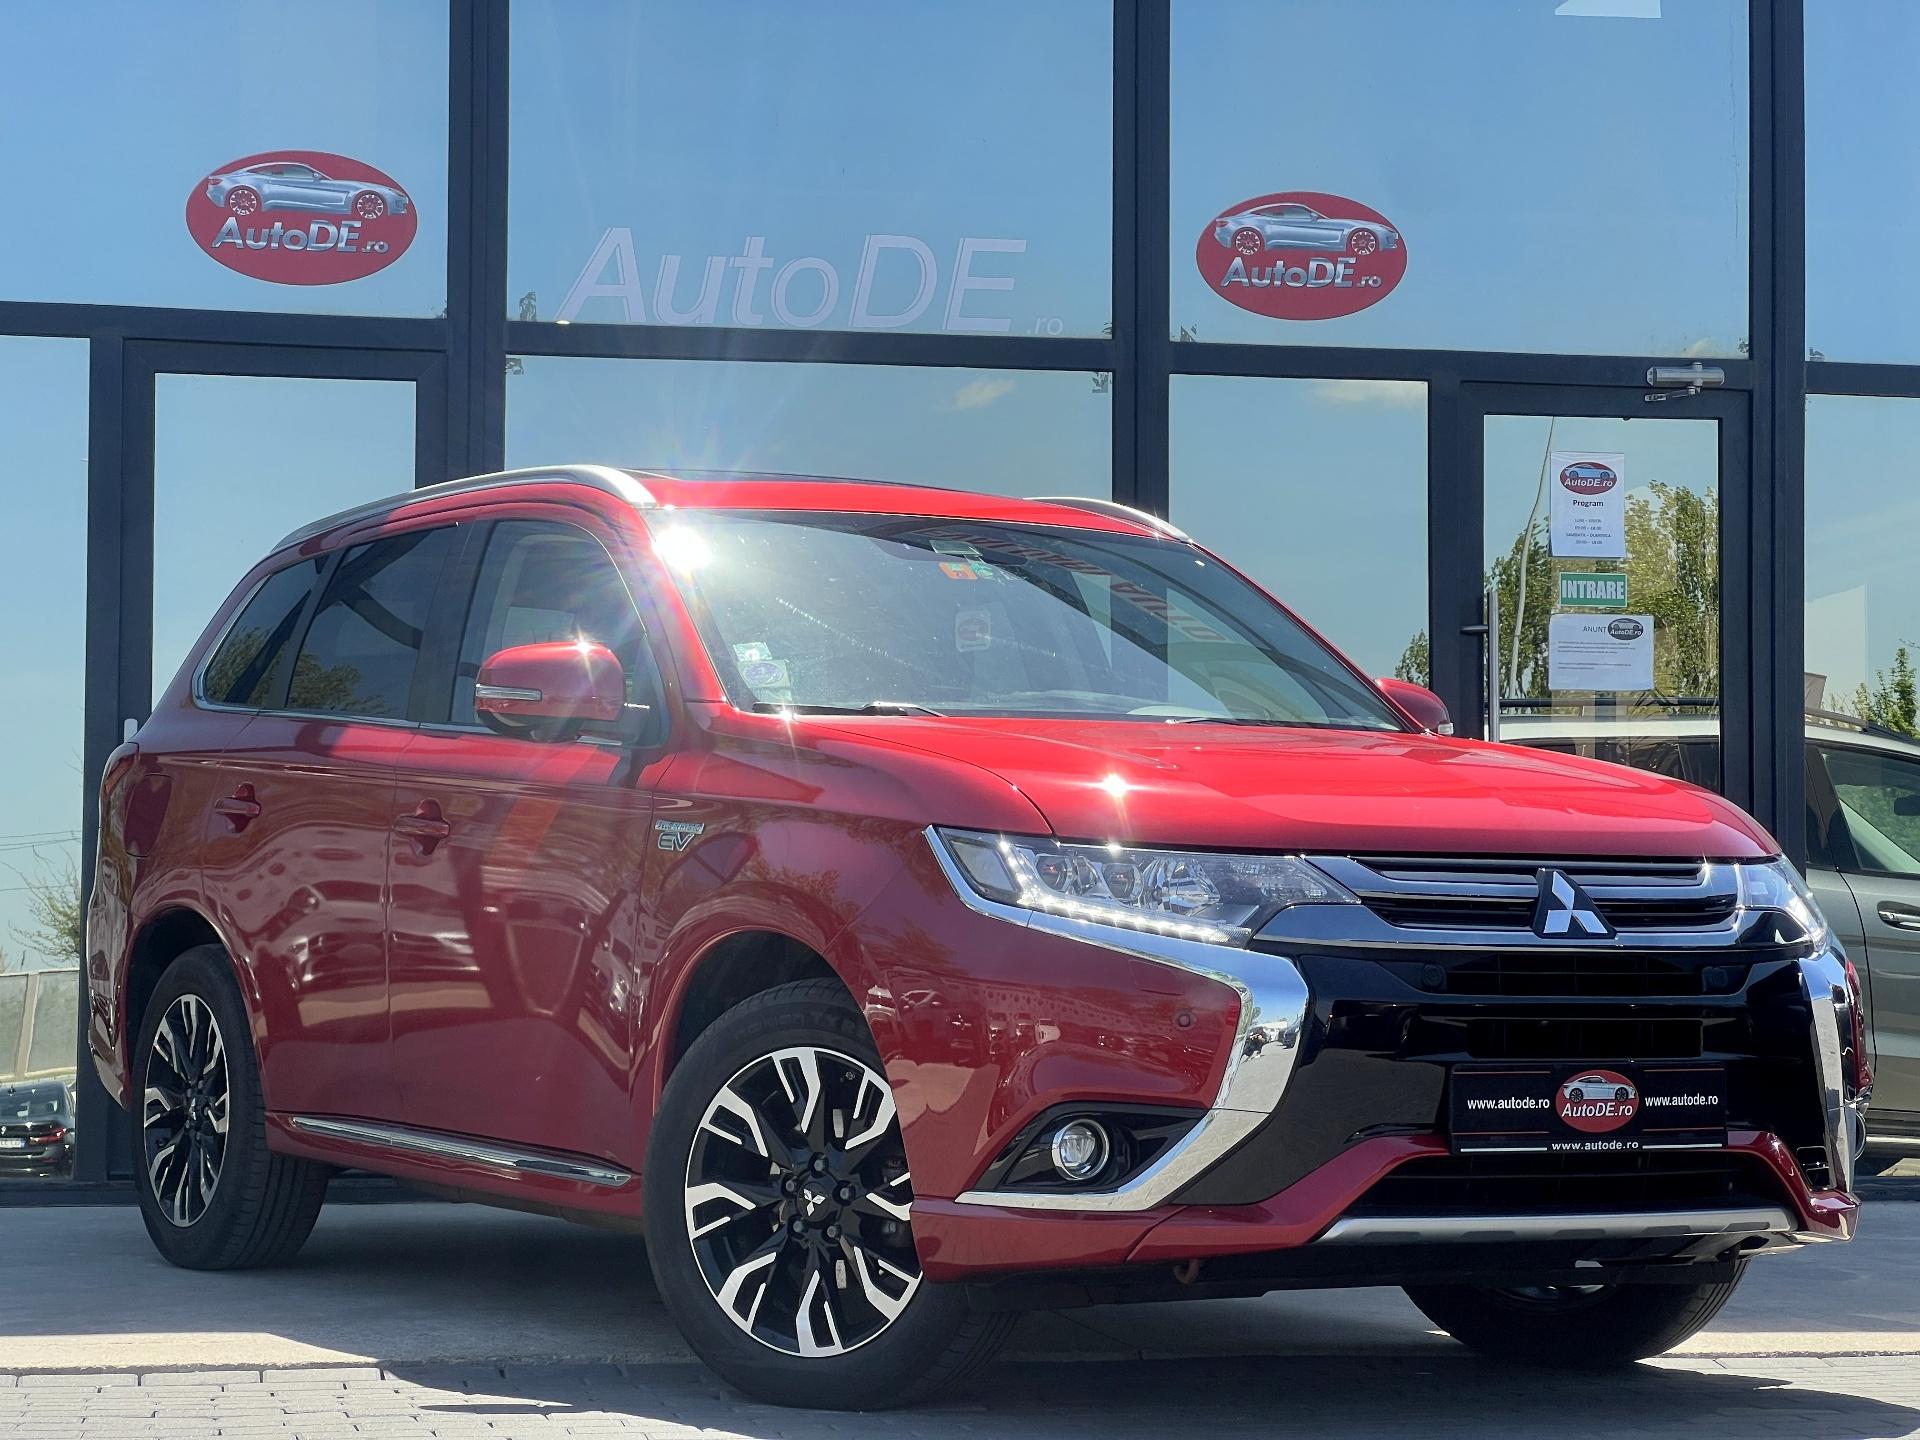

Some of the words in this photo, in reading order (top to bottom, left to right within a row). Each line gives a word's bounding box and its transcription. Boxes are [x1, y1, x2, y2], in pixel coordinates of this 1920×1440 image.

[1564, 478, 1613, 487] AutoDE.ro
[1572, 500, 1604, 508] Program
[1561, 580, 1625, 600] INTRARE
[657, 832, 695, 852] EV
[1467, 1097, 1551, 1110] www.autode.ro
[1644, 1093, 1719, 1108] www.autode.ro
[1561, 1102, 1634, 1119] AutoDE.ro
[1551, 1140, 1639, 1151] www.autode.ro
